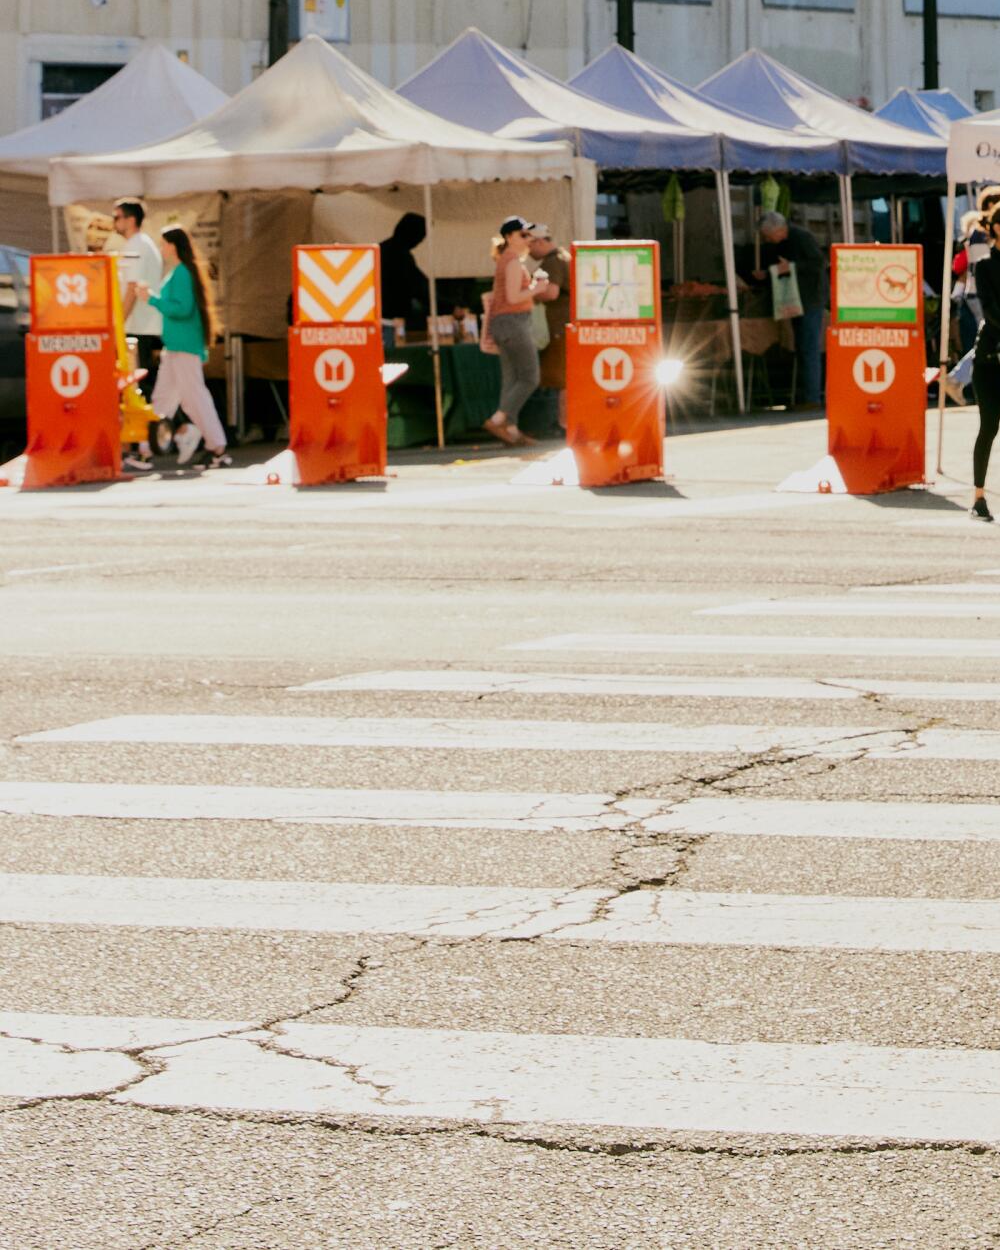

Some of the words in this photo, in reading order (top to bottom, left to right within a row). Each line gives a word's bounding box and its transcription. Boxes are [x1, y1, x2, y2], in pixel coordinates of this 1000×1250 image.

[40, 336, 98, 351] MERIDIAN
[303, 328, 364, 344] MERIDIAN
[581, 328, 643, 344] MERIDIAN
[841, 329, 907, 346] MERIDIAN
